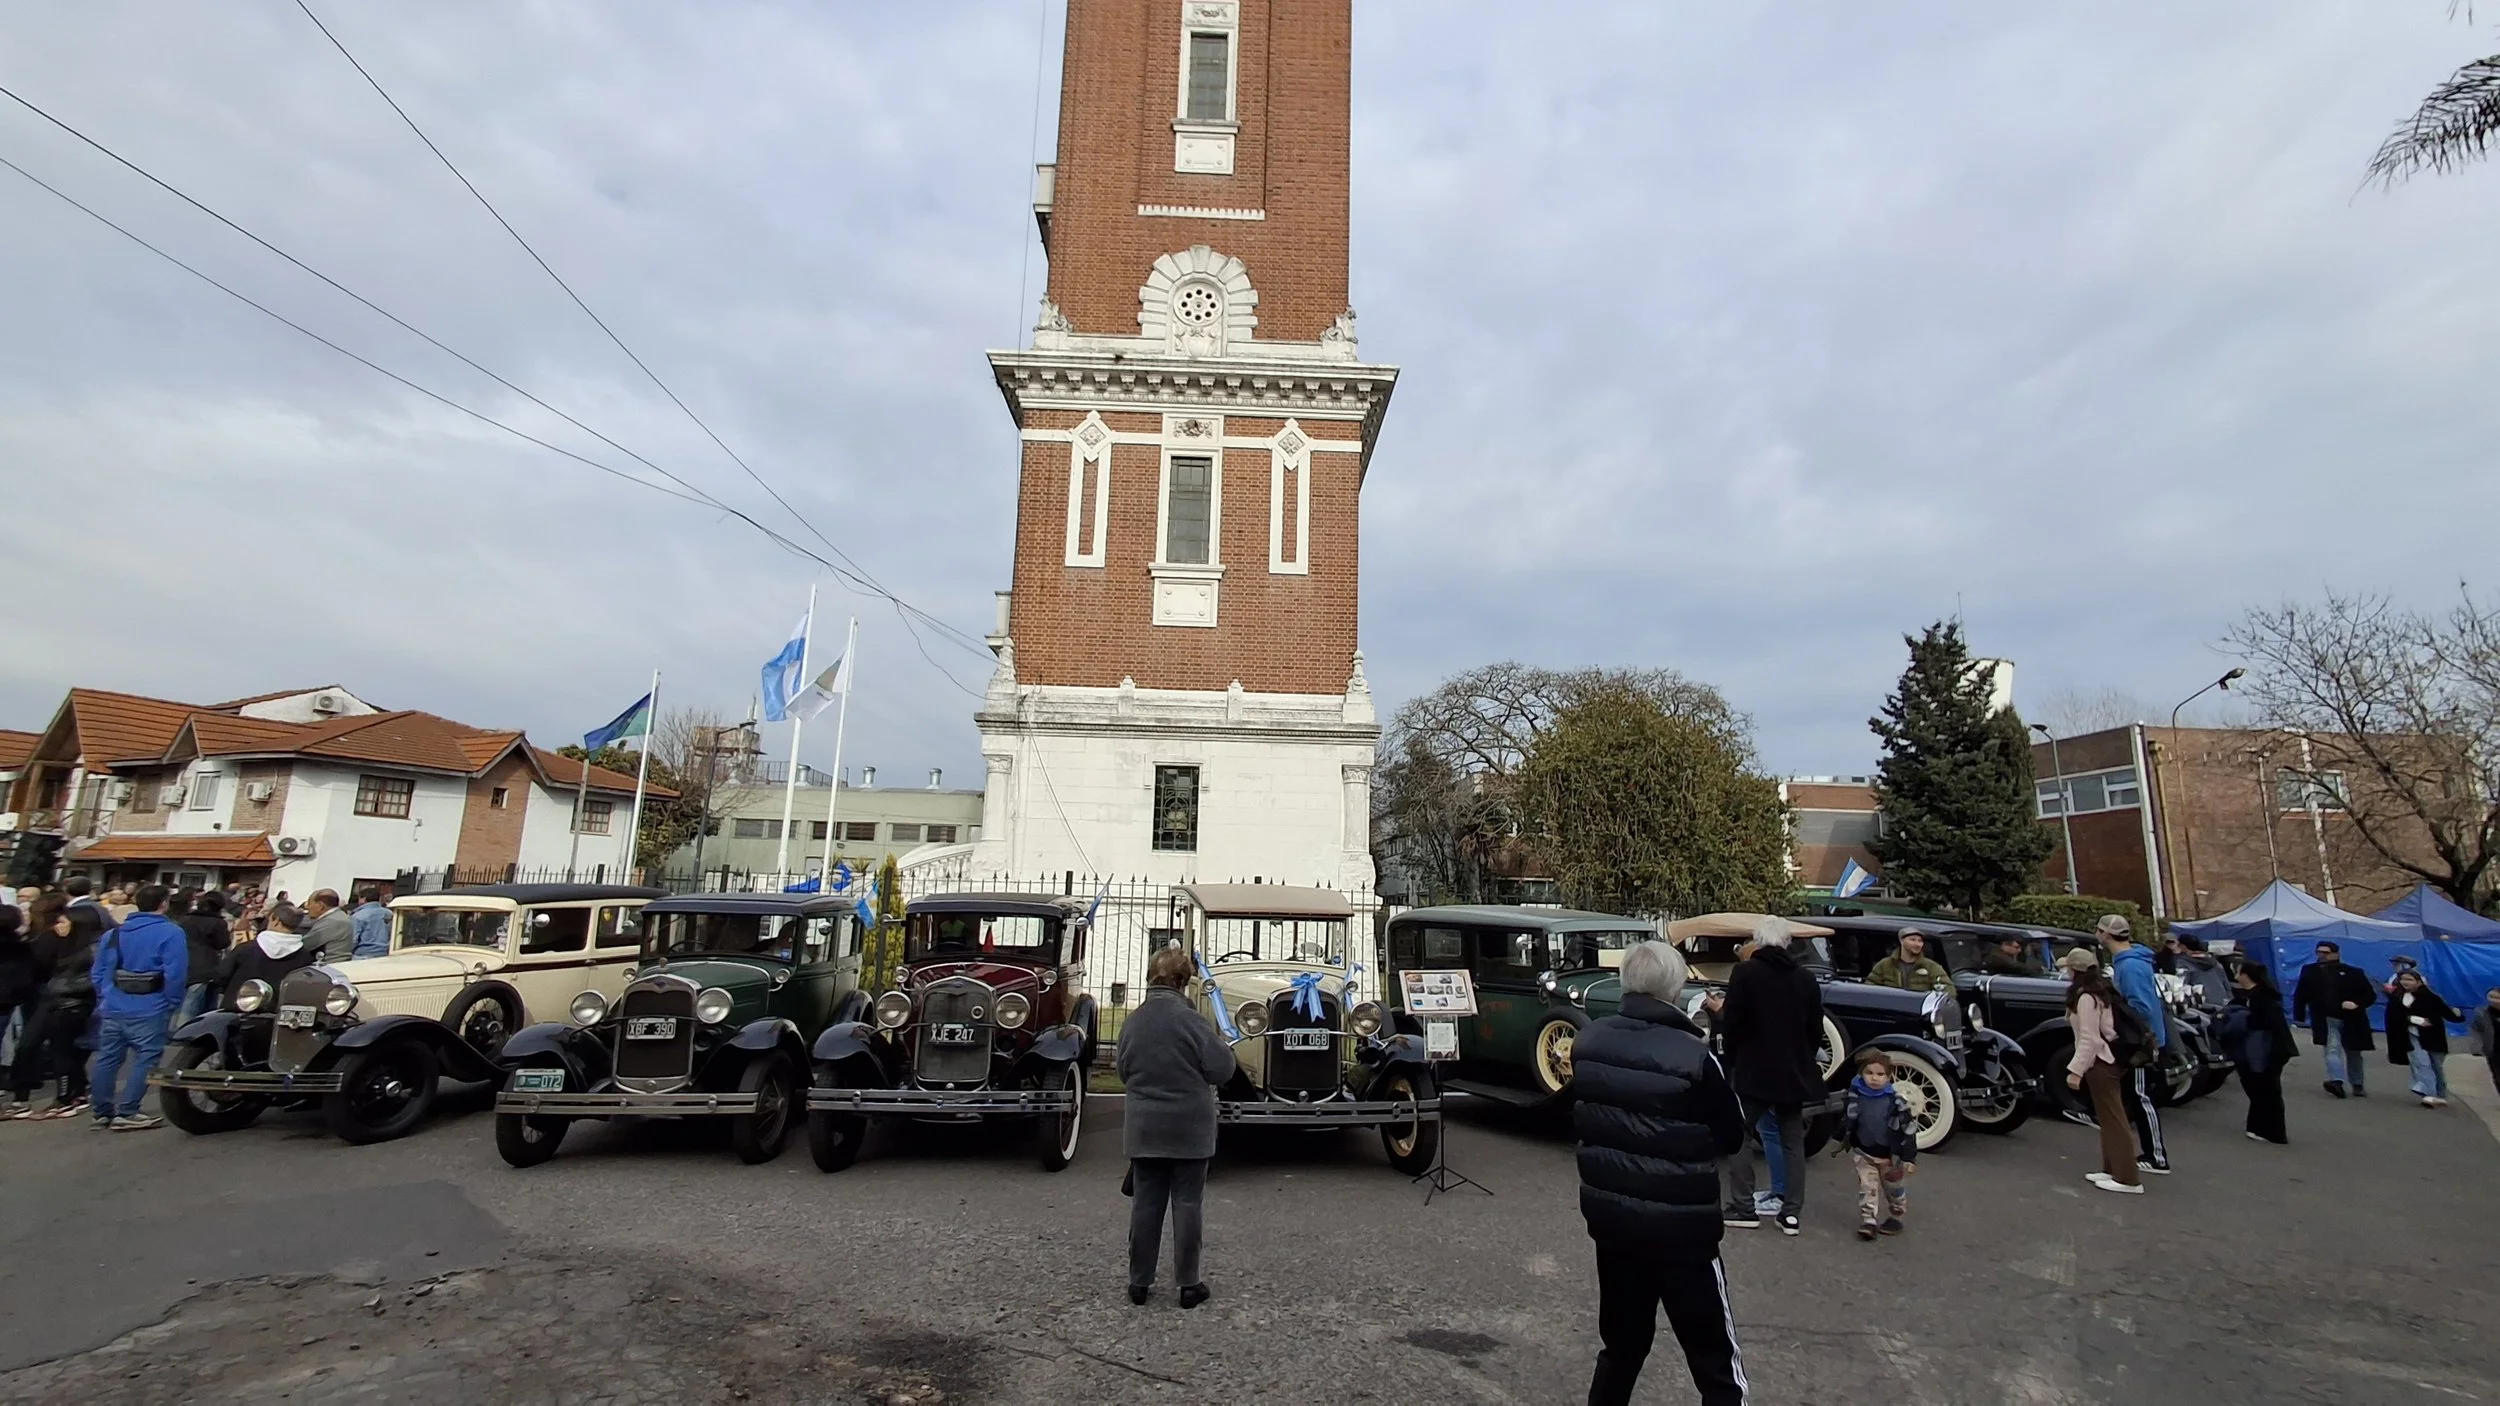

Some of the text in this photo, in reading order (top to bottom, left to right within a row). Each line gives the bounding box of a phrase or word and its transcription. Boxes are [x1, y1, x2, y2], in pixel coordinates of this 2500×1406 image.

[630, 1023, 674, 1035] XBF 390
[931, 1028, 974, 1041] XJE 247
[1286, 1034, 1327, 1046] XOT 068
[541, 1075, 562, 1088] 072
